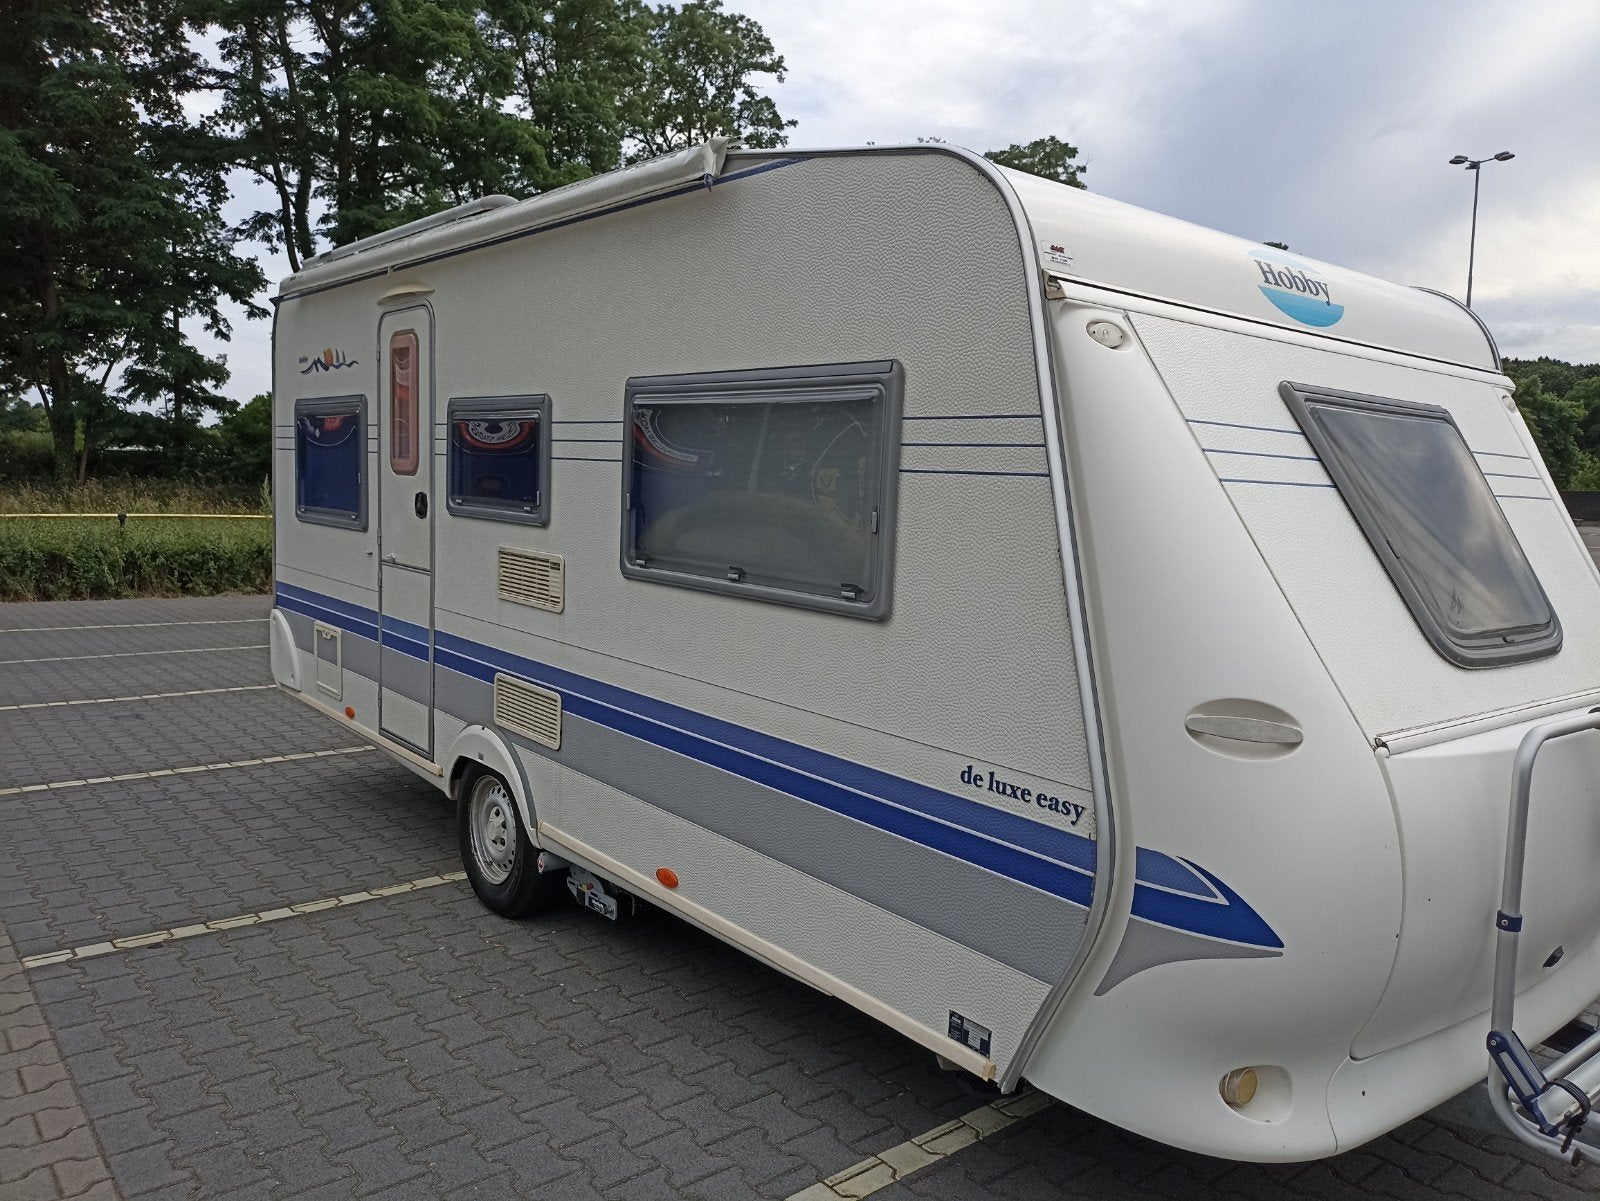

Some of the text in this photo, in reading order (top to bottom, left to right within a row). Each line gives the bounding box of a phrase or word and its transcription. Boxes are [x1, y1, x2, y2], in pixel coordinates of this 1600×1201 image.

[1255, 260, 1331, 306] Hobby
[960, 765, 1086, 826] de luxe easy
